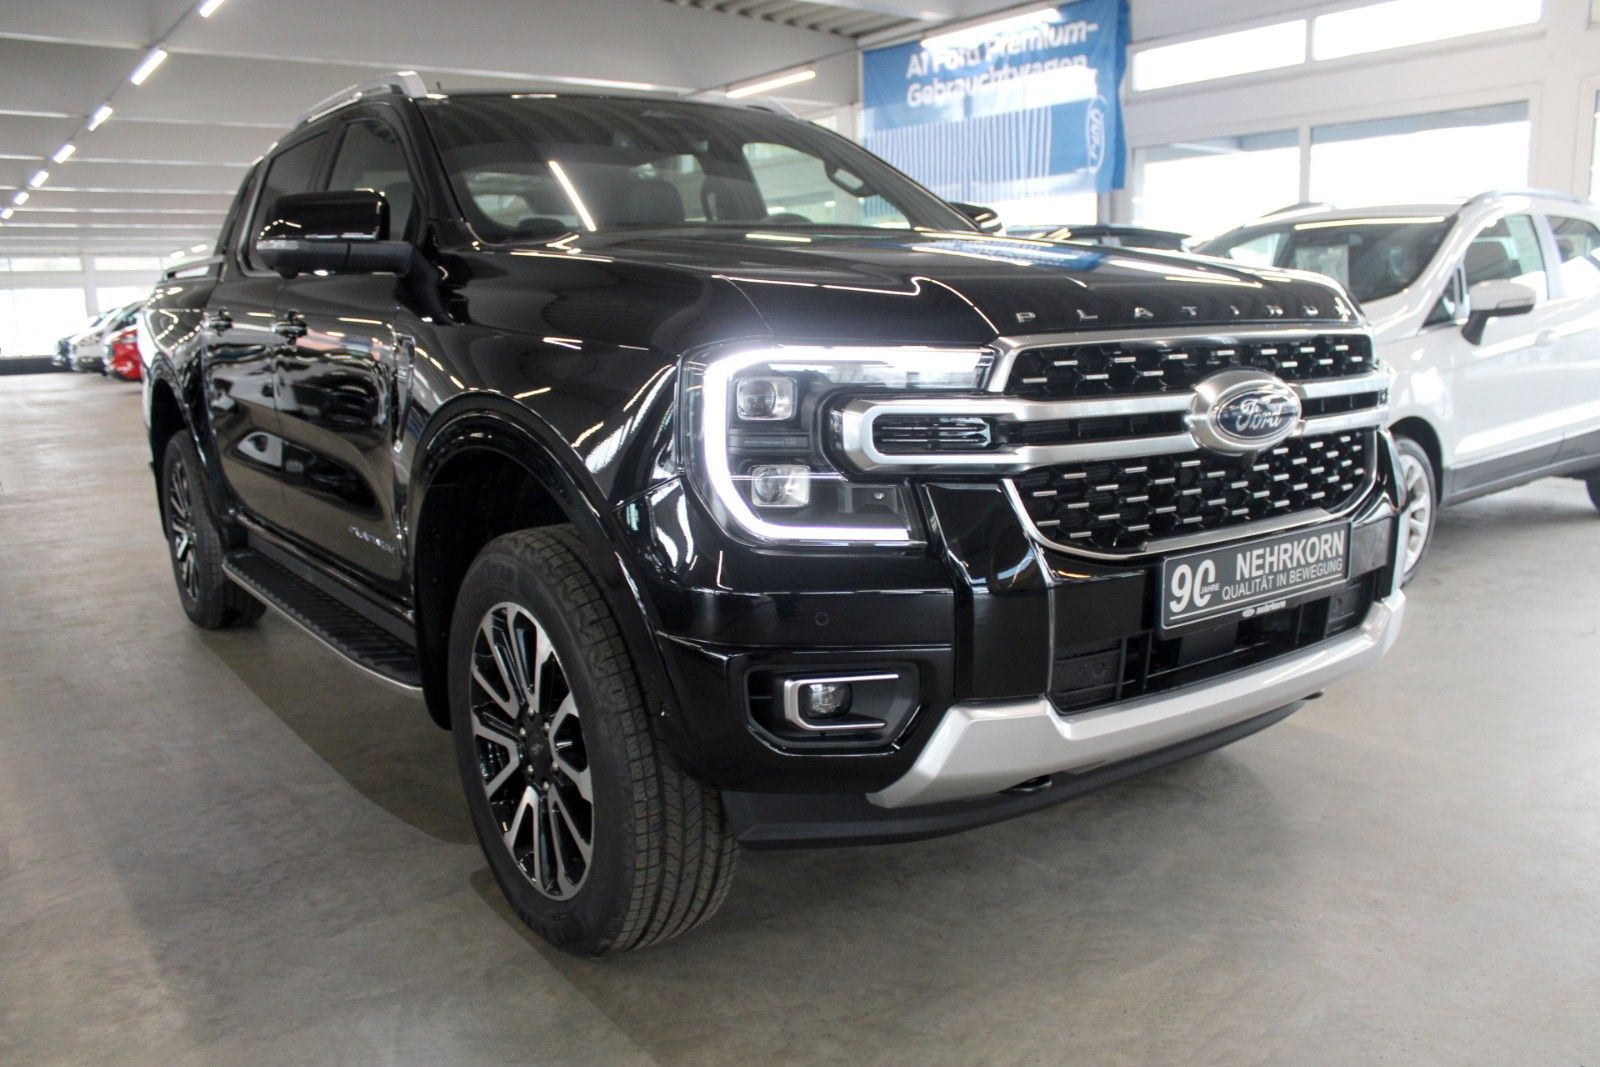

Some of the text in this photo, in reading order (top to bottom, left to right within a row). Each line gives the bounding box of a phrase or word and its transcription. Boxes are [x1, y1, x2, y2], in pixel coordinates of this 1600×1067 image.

[1235, 398, 1284, 432] Ford
[1236, 530, 1345, 581] NEHRKORN
[1169, 559, 1216, 614] 90
[1200, 582, 1220, 595] JAHRE
[1222, 558, 1343, 600] QUALITÄT IN BEWEGUNG
